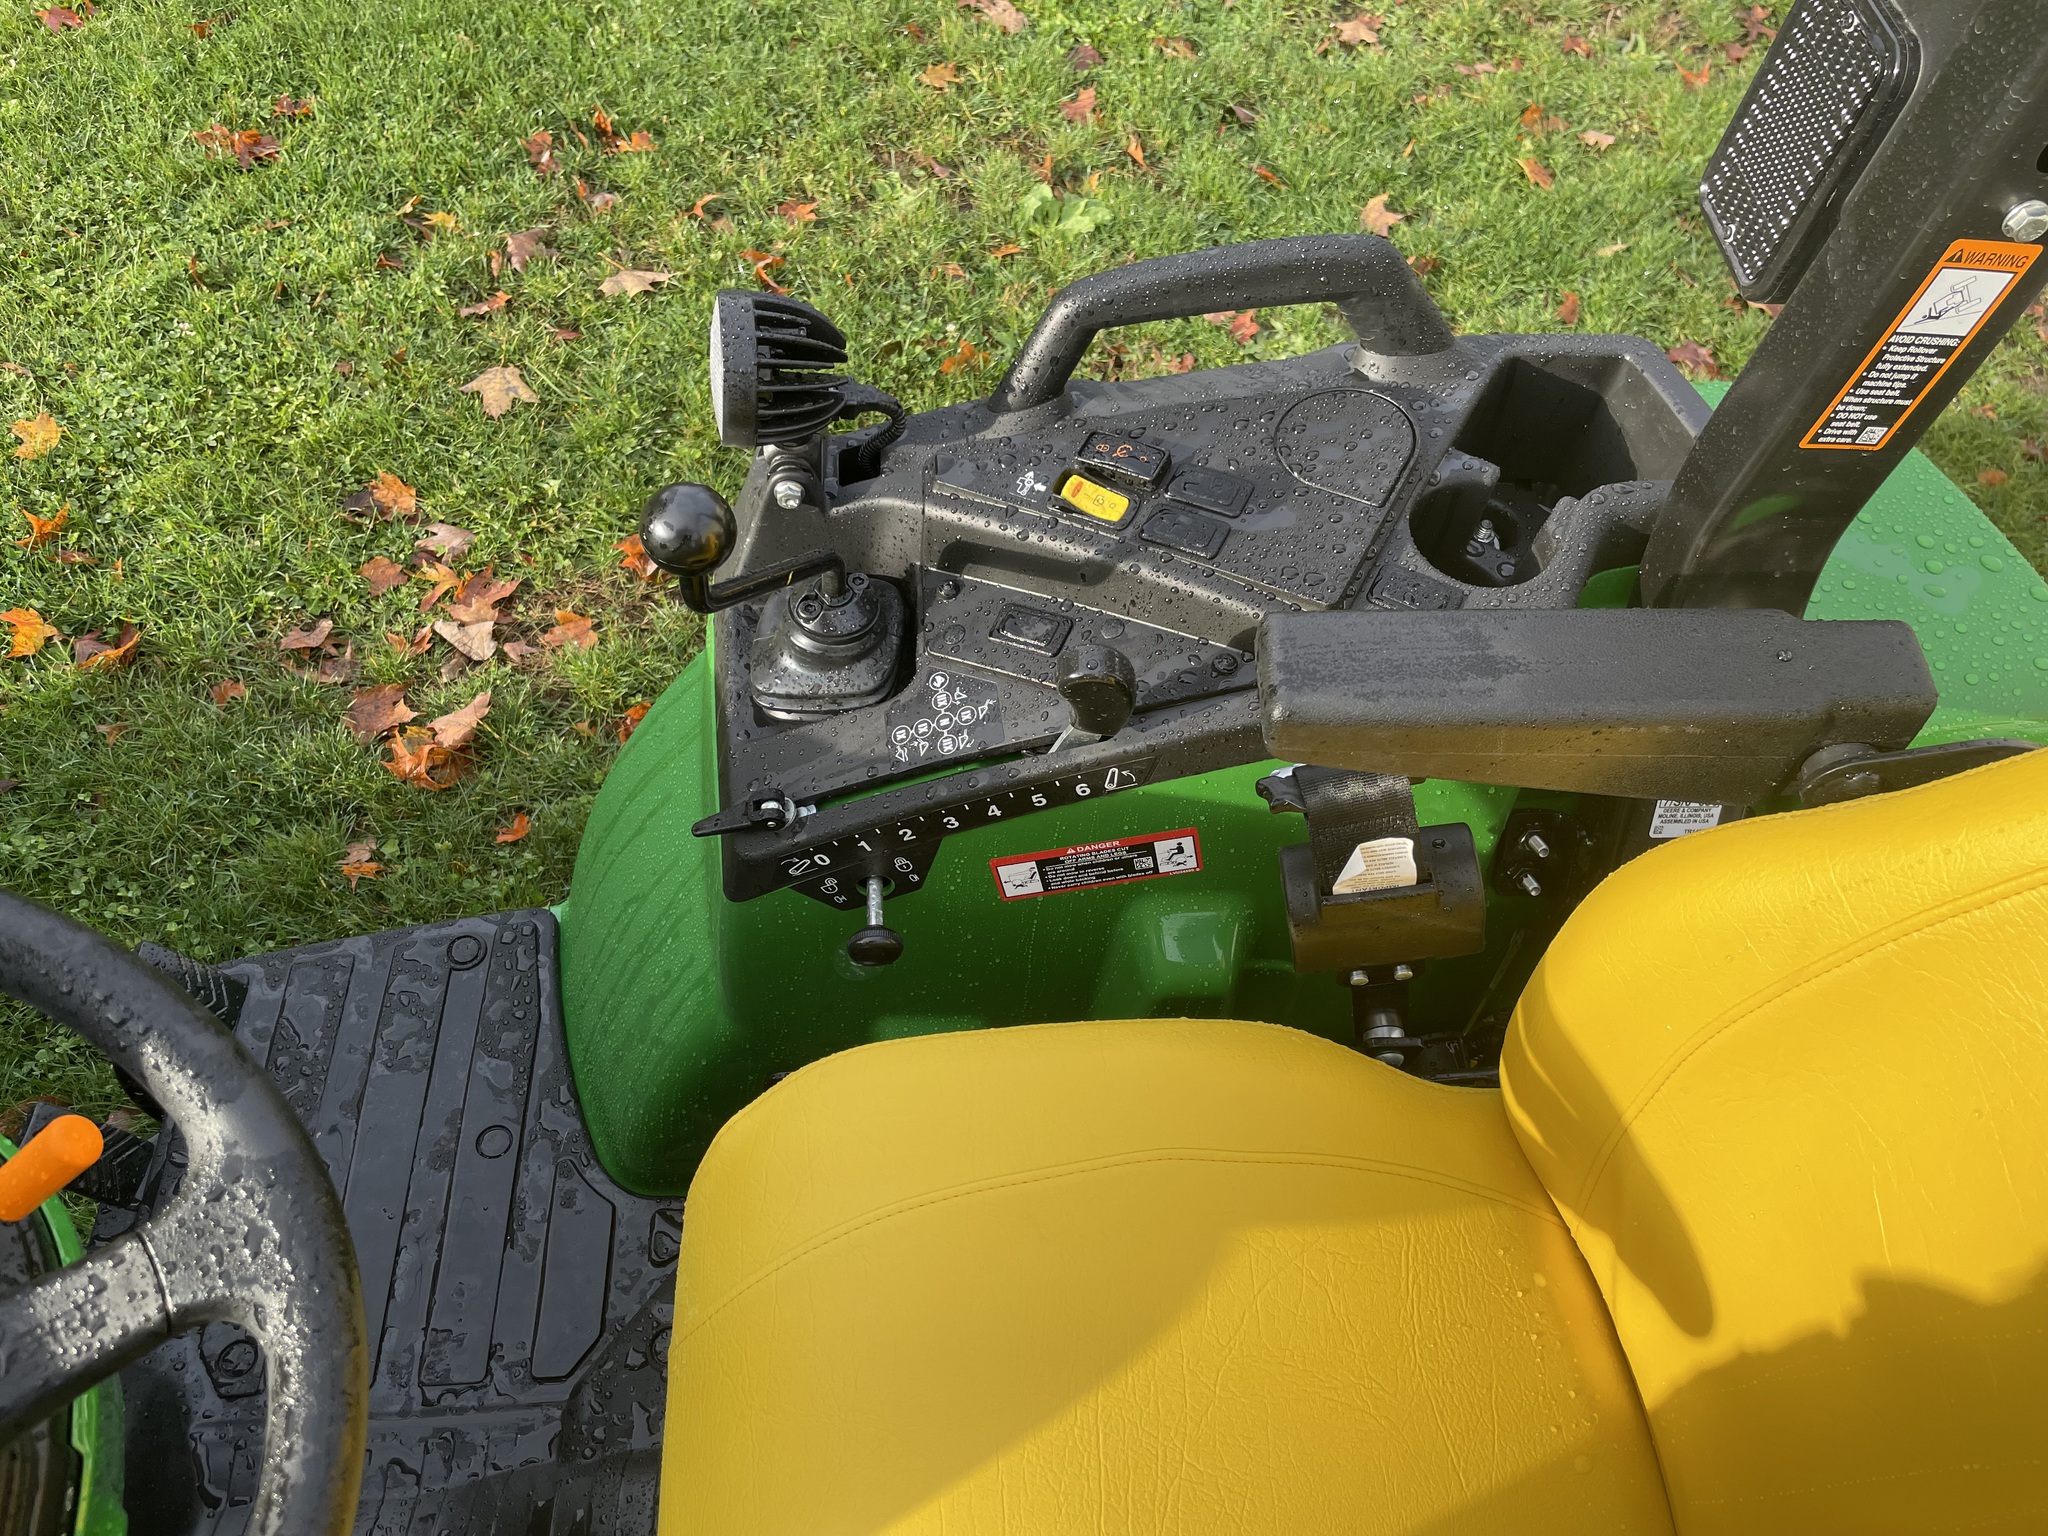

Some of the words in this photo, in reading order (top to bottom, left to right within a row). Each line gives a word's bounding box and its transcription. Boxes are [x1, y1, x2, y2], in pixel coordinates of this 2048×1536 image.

[1964, 251, 2029, 268] WARNING
[1888, 335, 1915, 344] AVOID
[1914, 336, 1961, 346] CRUSHING:
[1888, 345, 1907, 354] Keep
[1907, 346, 1938, 354] Rollover
[1882, 354, 1915, 362] Protective
[1915, 356, 1946, 364] Structure
[1875, 362, 1893, 371] fully
[1893, 364, 1928, 372] extended.
[1890, 372, 1910, 380] jump
[814, 854, 830, 866] 0
[857, 841, 872, 852] 1
[898, 829, 916, 842] 2
[943, 816, 959, 829] 3
[987, 805, 1002, 817] 4
[1031, 794, 1047, 806] 5
[1075, 783, 1091, 796] 6
[1077, 840, 1120, 852] DANGER
[1060, 852, 1090, 860] ROTATING
